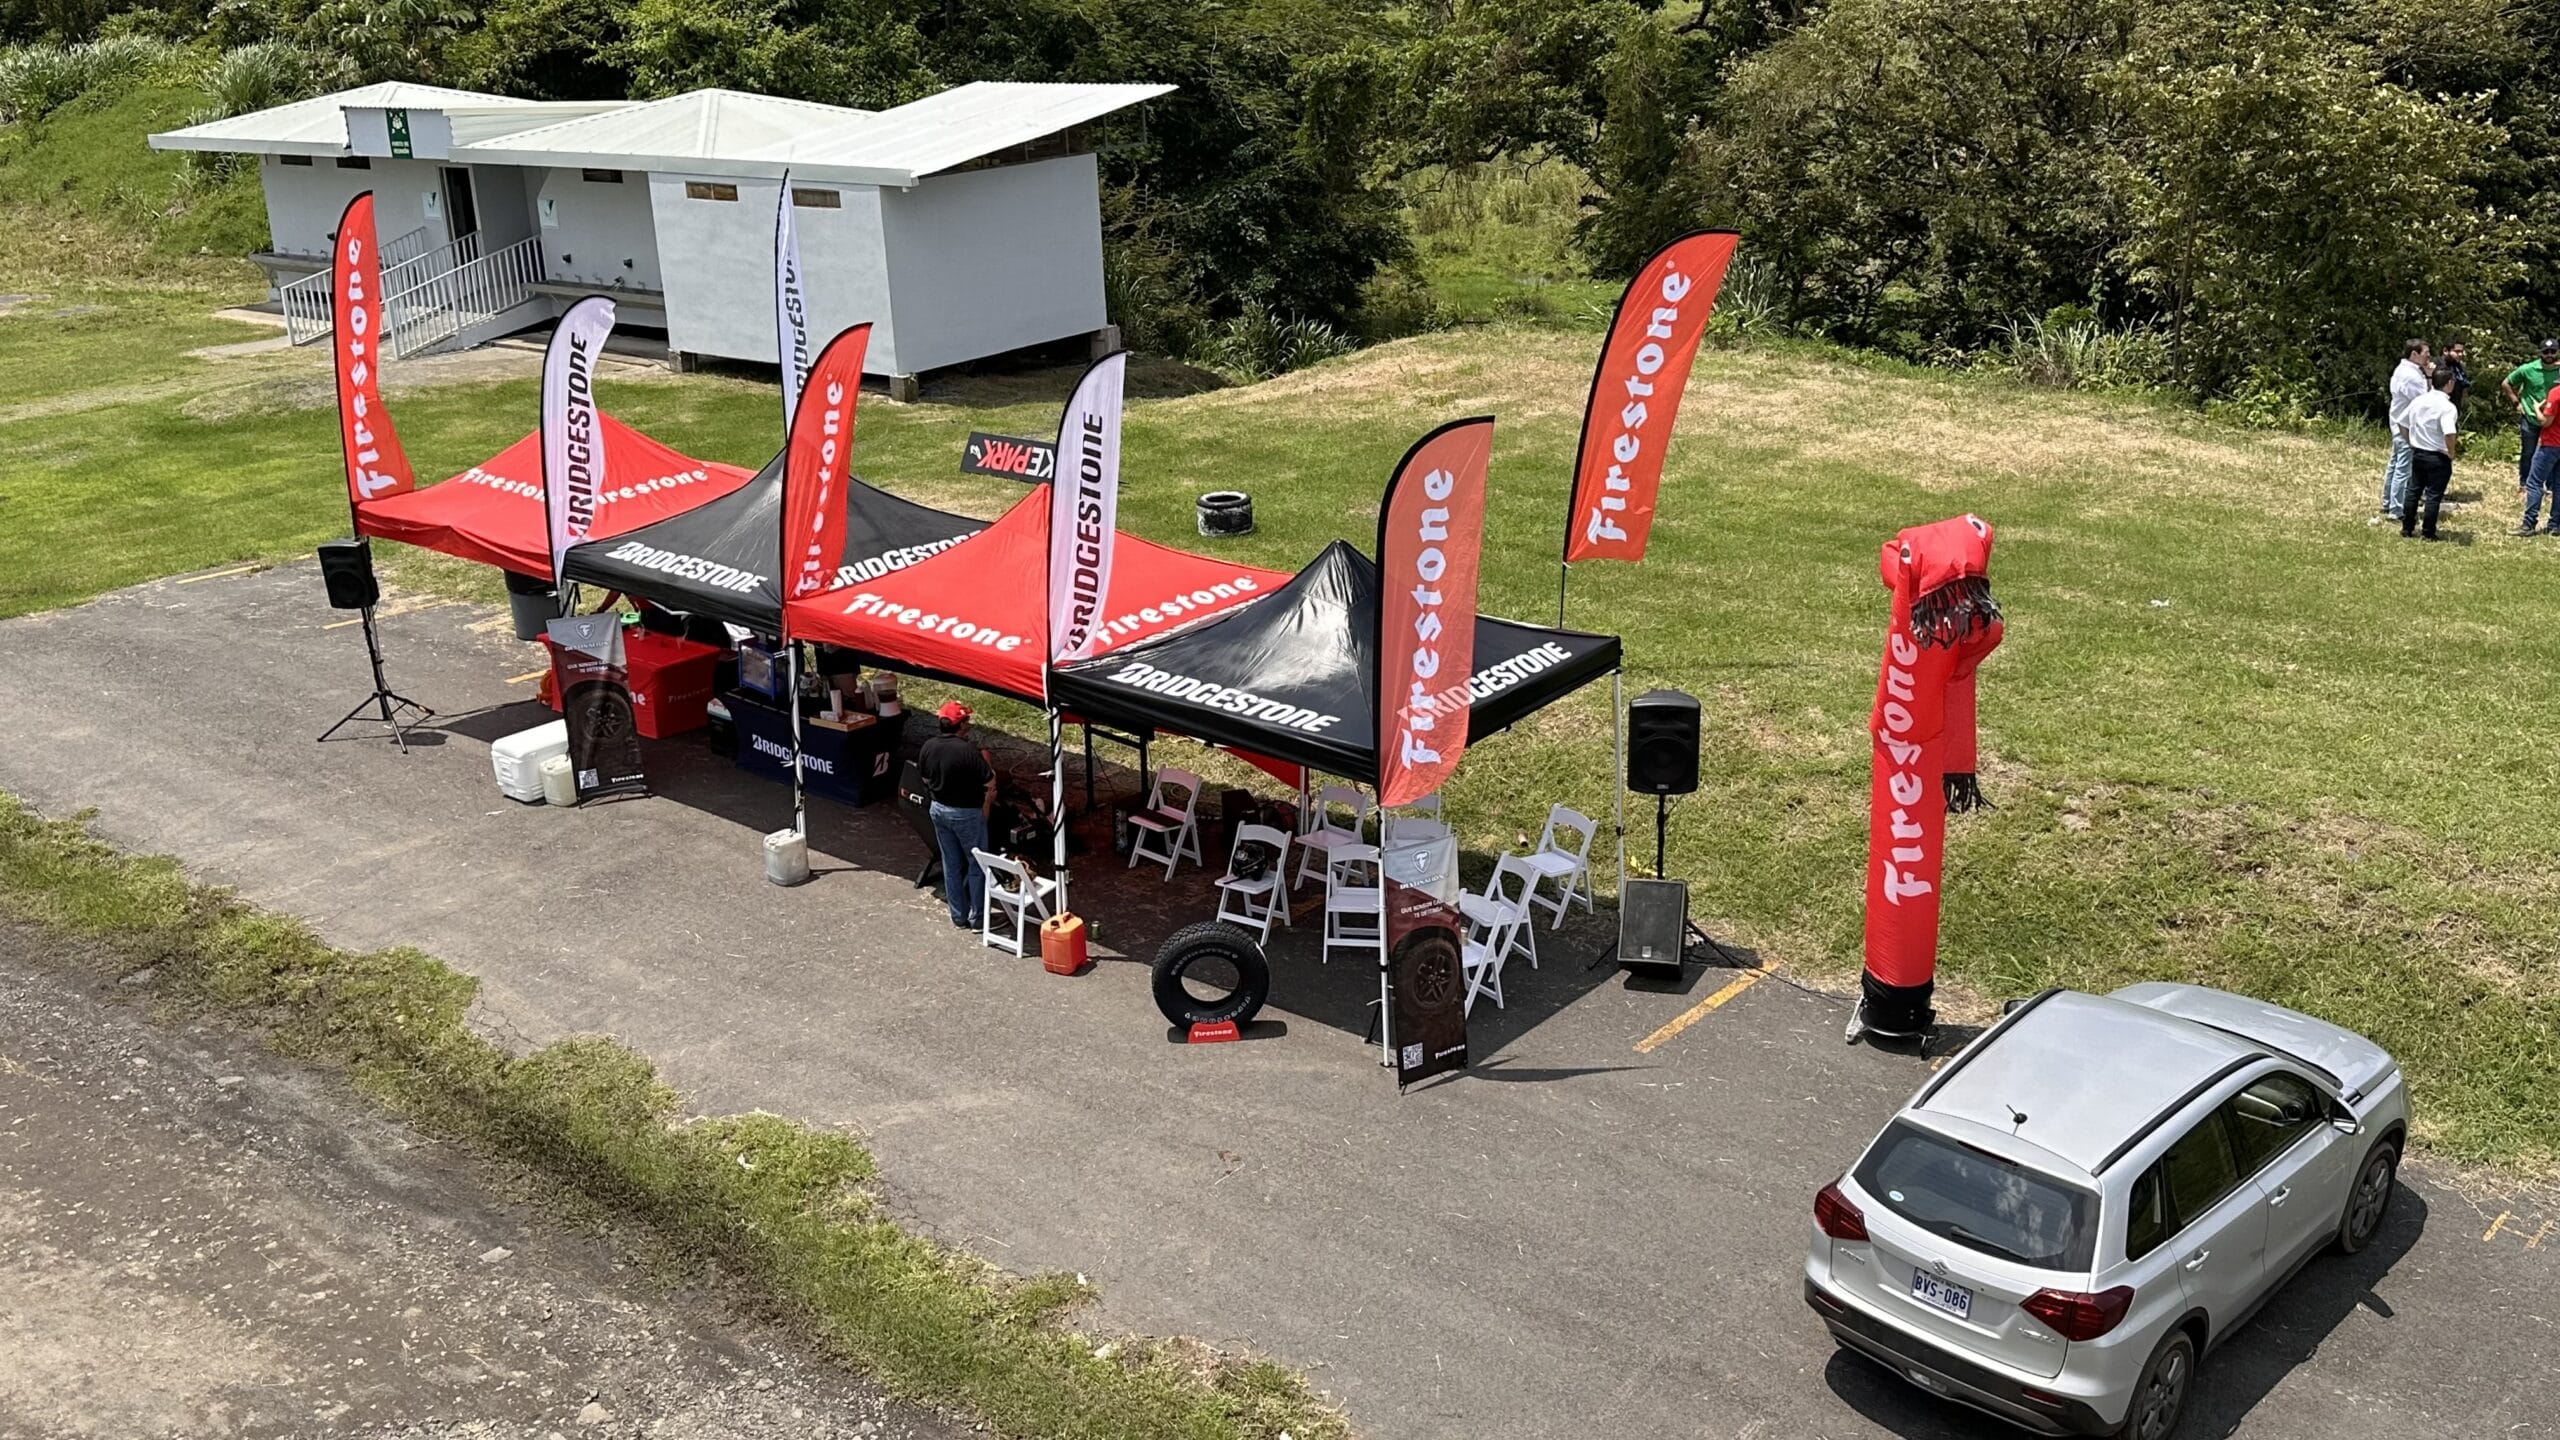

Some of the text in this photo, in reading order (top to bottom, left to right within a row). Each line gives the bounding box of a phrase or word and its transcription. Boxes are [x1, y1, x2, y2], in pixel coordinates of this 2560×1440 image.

[784, 251, 809, 400] RIDGESTO
[348, 237, 397, 499] Firestone
[567, 332, 594, 538] BRIDGESTONE
[1587, 272, 1691, 545] Firestone
[596, 469, 708, 505] irestone
[976, 439, 1055, 479] KEPARK
[606, 541, 768, 593] BRIDGESTONE
[829, 530, 981, 591] RIDGESTO
[1064, 412, 1103, 652] BRIDGESTONE
[843, 593, 1021, 652] Firestone
[1096, 575, 1258, 646] Firestone
[1401, 468, 1454, 770] Firestone
[1107, 661, 1341, 732] BRIDGESTONE
[752, 734, 834, 775] BRIDGTONE
[1878, 633, 1932, 907] Firestone
[1915, 1274, 1968, 1310] BVS-086
